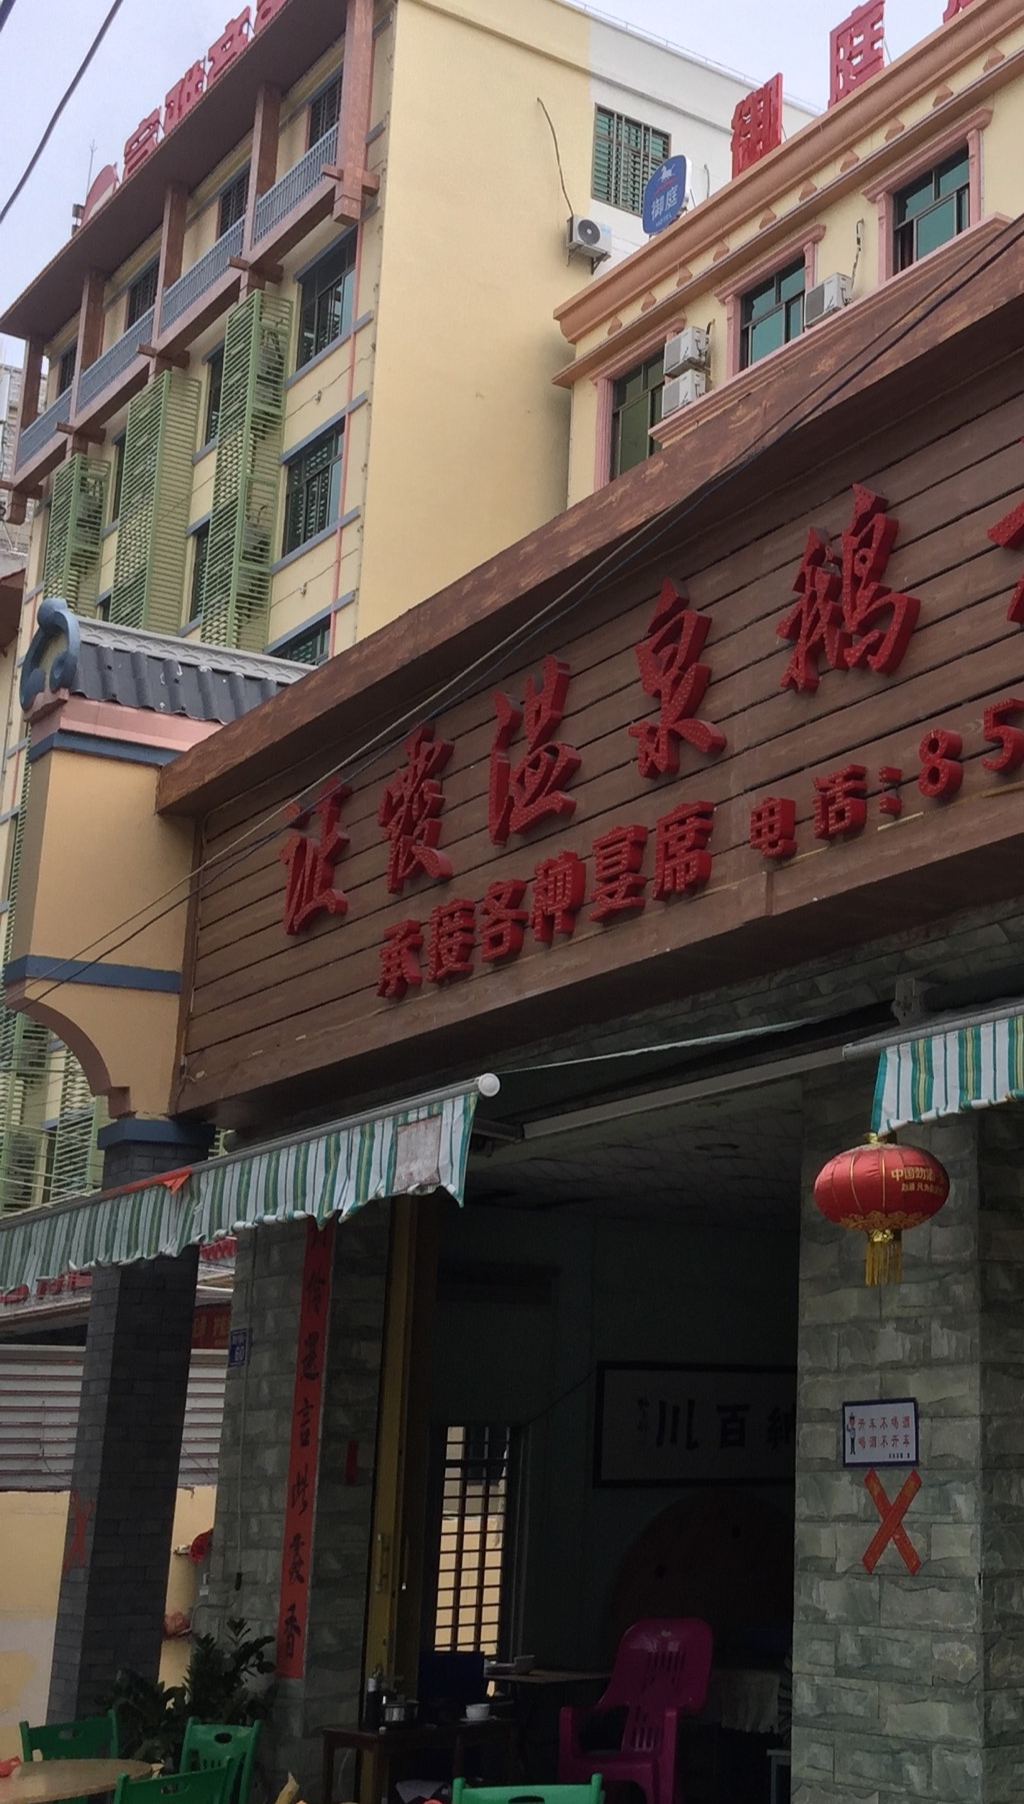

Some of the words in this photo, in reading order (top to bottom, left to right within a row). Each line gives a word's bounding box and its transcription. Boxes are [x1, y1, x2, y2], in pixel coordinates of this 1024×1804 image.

[651, 184, 679, 221] 御庭
[655, 212, 673, 227] HOTEL
[377, 800, 715, 998] 承接各种宴席
[858, 1415, 910, 1430] 开车不喝酒
[858, 1434, 910, 1449] 喝酒不开车
